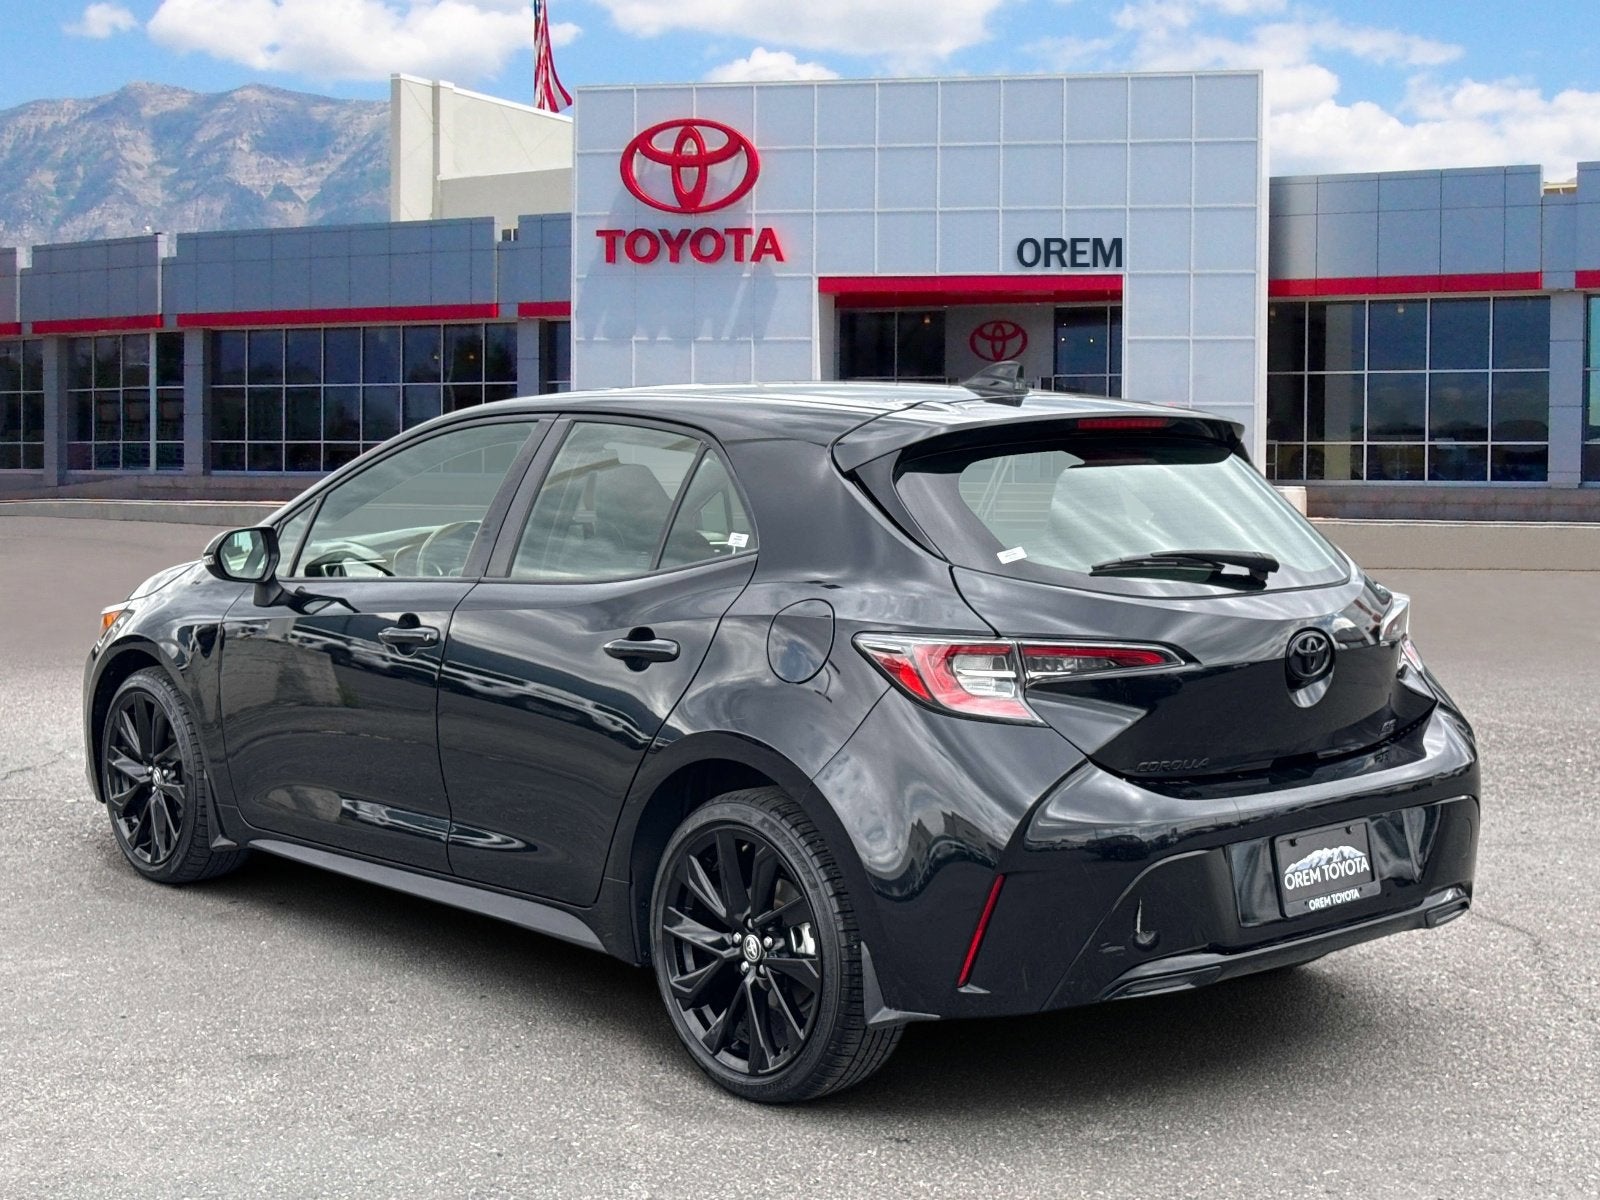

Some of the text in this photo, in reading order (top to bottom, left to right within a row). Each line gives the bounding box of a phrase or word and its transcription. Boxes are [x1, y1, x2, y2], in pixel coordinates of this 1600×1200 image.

[596, 227, 785, 264] TOYOTA
[1017, 237, 1123, 268] OREM
[1136, 757, 1210, 773] COROLLA
[1284, 856, 1370, 890] OREM TOYOTA
[1308, 888, 1360, 911] OREM TOYOTA
